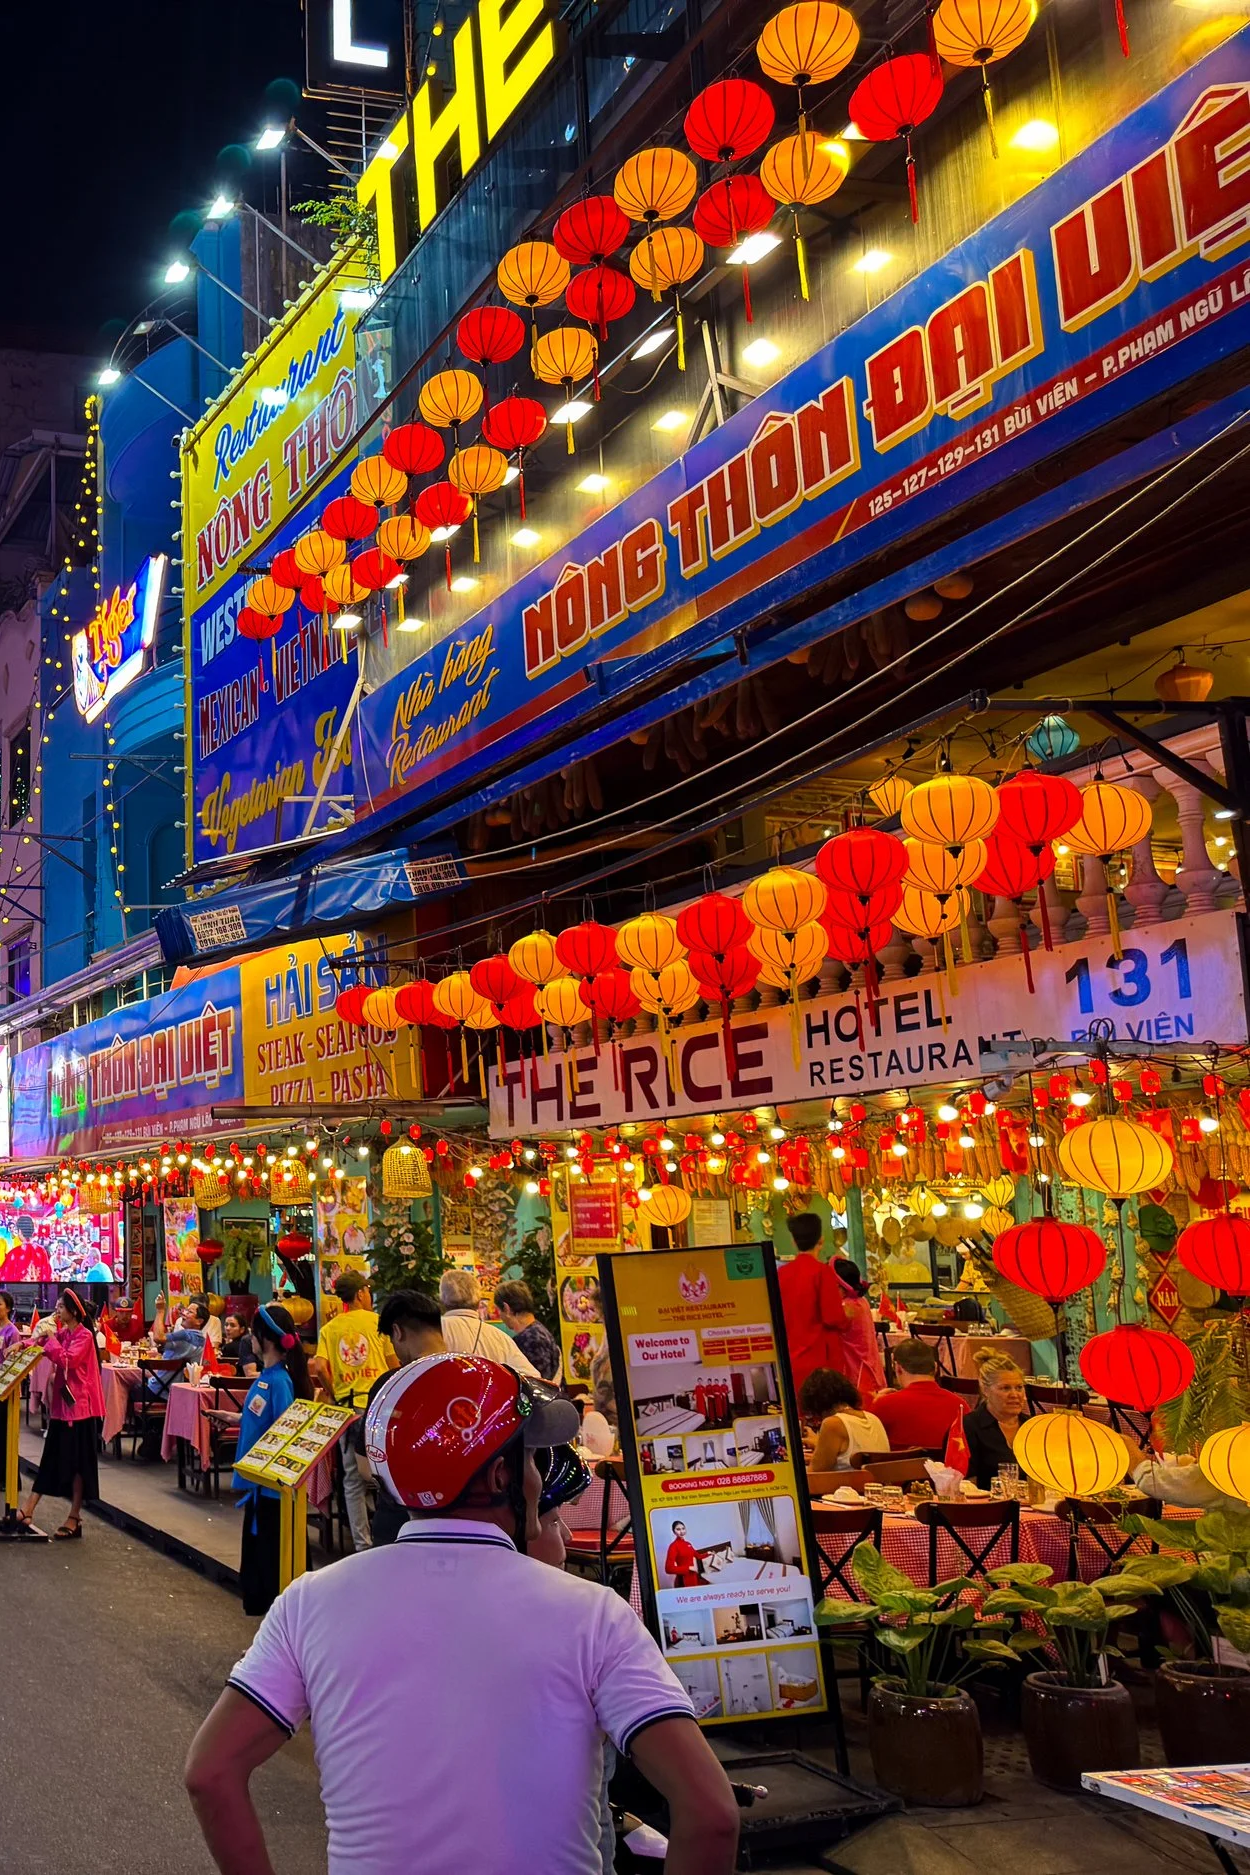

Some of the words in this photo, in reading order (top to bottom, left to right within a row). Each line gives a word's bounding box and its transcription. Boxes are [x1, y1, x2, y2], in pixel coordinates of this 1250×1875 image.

[868, 425, 999, 518] 125-127-129-131
[1101, 318, 1175, 379] P.PHẠM
[1179, 285, 1224, 333] NGŨ
[522, 518, 667, 680] NÔNG
[667, 375, 860, 579] THÔN
[862, 247, 1045, 454] ĐẠI
[196, 459, 272, 591] NÔNG
[89, 582, 137, 668] Tiger
[199, 666, 260, 761] MEXICAN
[392, 672, 436, 741] Nhà
[438, 623, 496, 693] hàng
[385, 667, 500, 789] Restaurant
[201, 759, 306, 853] Vegetarian
[264, 953, 313, 1029] HẢI
[805, 989, 952, 1048] HOTEL
[1065, 937, 1192, 1015] 131
[89, 1033, 138, 1107] THÔN
[139, 1024, 177, 1099] ĐẠI
[178, 1000, 236, 1089] VIỆT
[257, 1032, 306, 1076] STEAK
[270, 1077, 315, 1106] PIZZA
[330, 1061, 389, 1103] PASTA
[495, 1056, 601, 1127] THE
[622, 1022, 773, 1113] RICE
[635, 1337, 679, 1349] Welcome
[681, 1336, 690, 1345] to
[642, 1350, 659, 1361] Our
[659, 1348, 686, 1360] Hotel
[668, 1481, 698, 1490] BOOKING
[698, 1479, 714, 1487] NOW
[676, 1595, 688, 1604] We
[689, 1595, 701, 1603] are
[702, 1591, 725, 1603] always
[726, 1590, 746, 1600] ready
[747, 1588, 755, 1597] to
[756, 1588, 775, 1596] serve
[776, 1584, 792, 1594] you!
